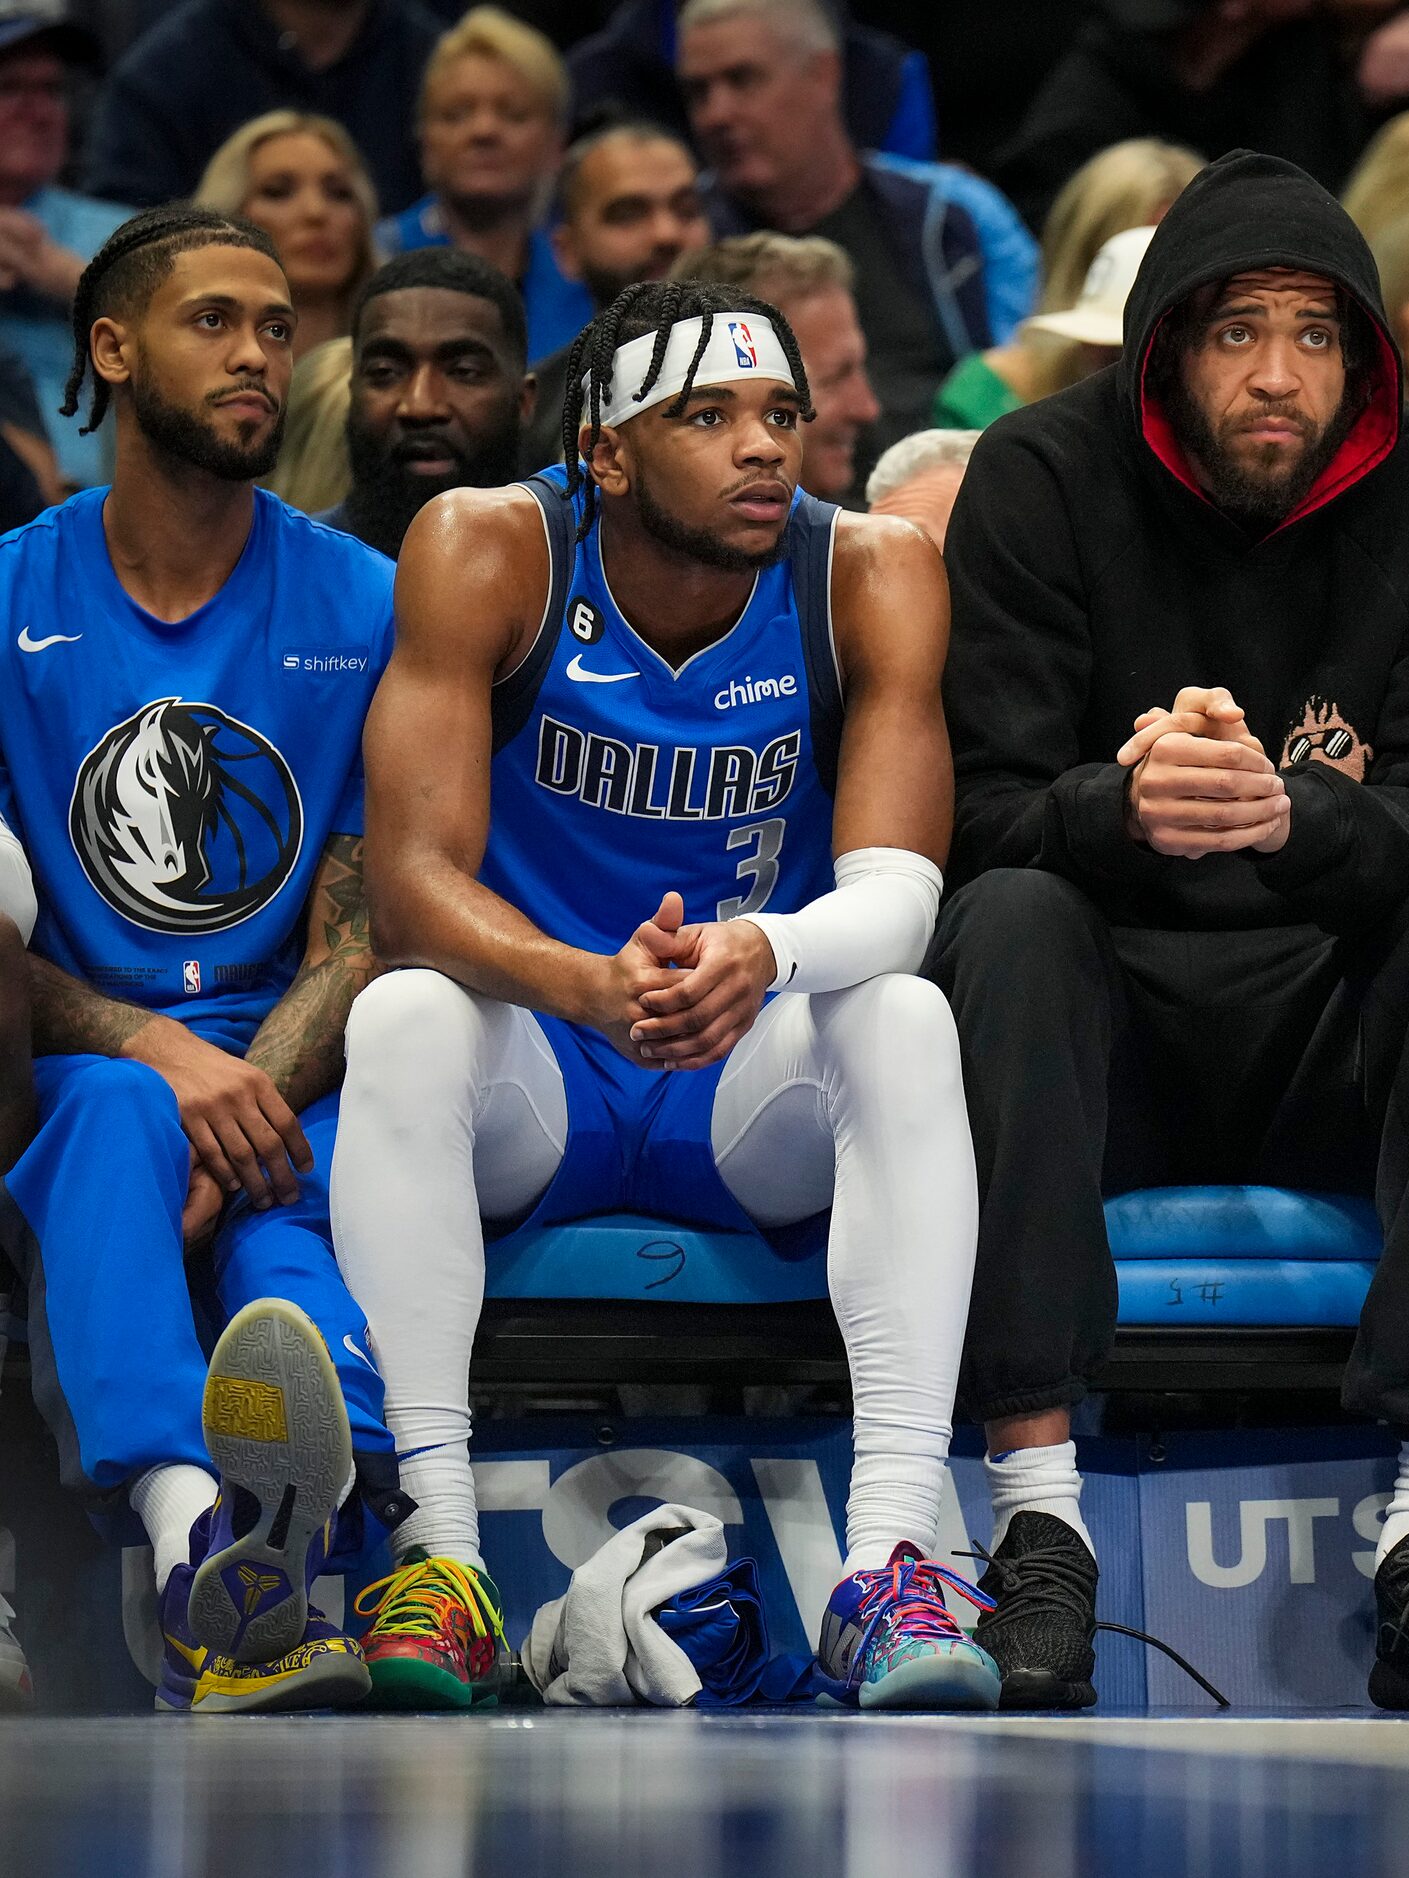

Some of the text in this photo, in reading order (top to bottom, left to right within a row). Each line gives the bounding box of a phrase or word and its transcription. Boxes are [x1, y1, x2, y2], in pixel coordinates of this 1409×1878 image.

[572, 603, 595, 640] 6
[304, 655, 368, 672] shiftkey
[714, 674, 798, 710] chime
[535, 714, 801, 821] DALLAS
[716, 817, 787, 922] 3
[1185, 1498, 1340, 1588] UT
